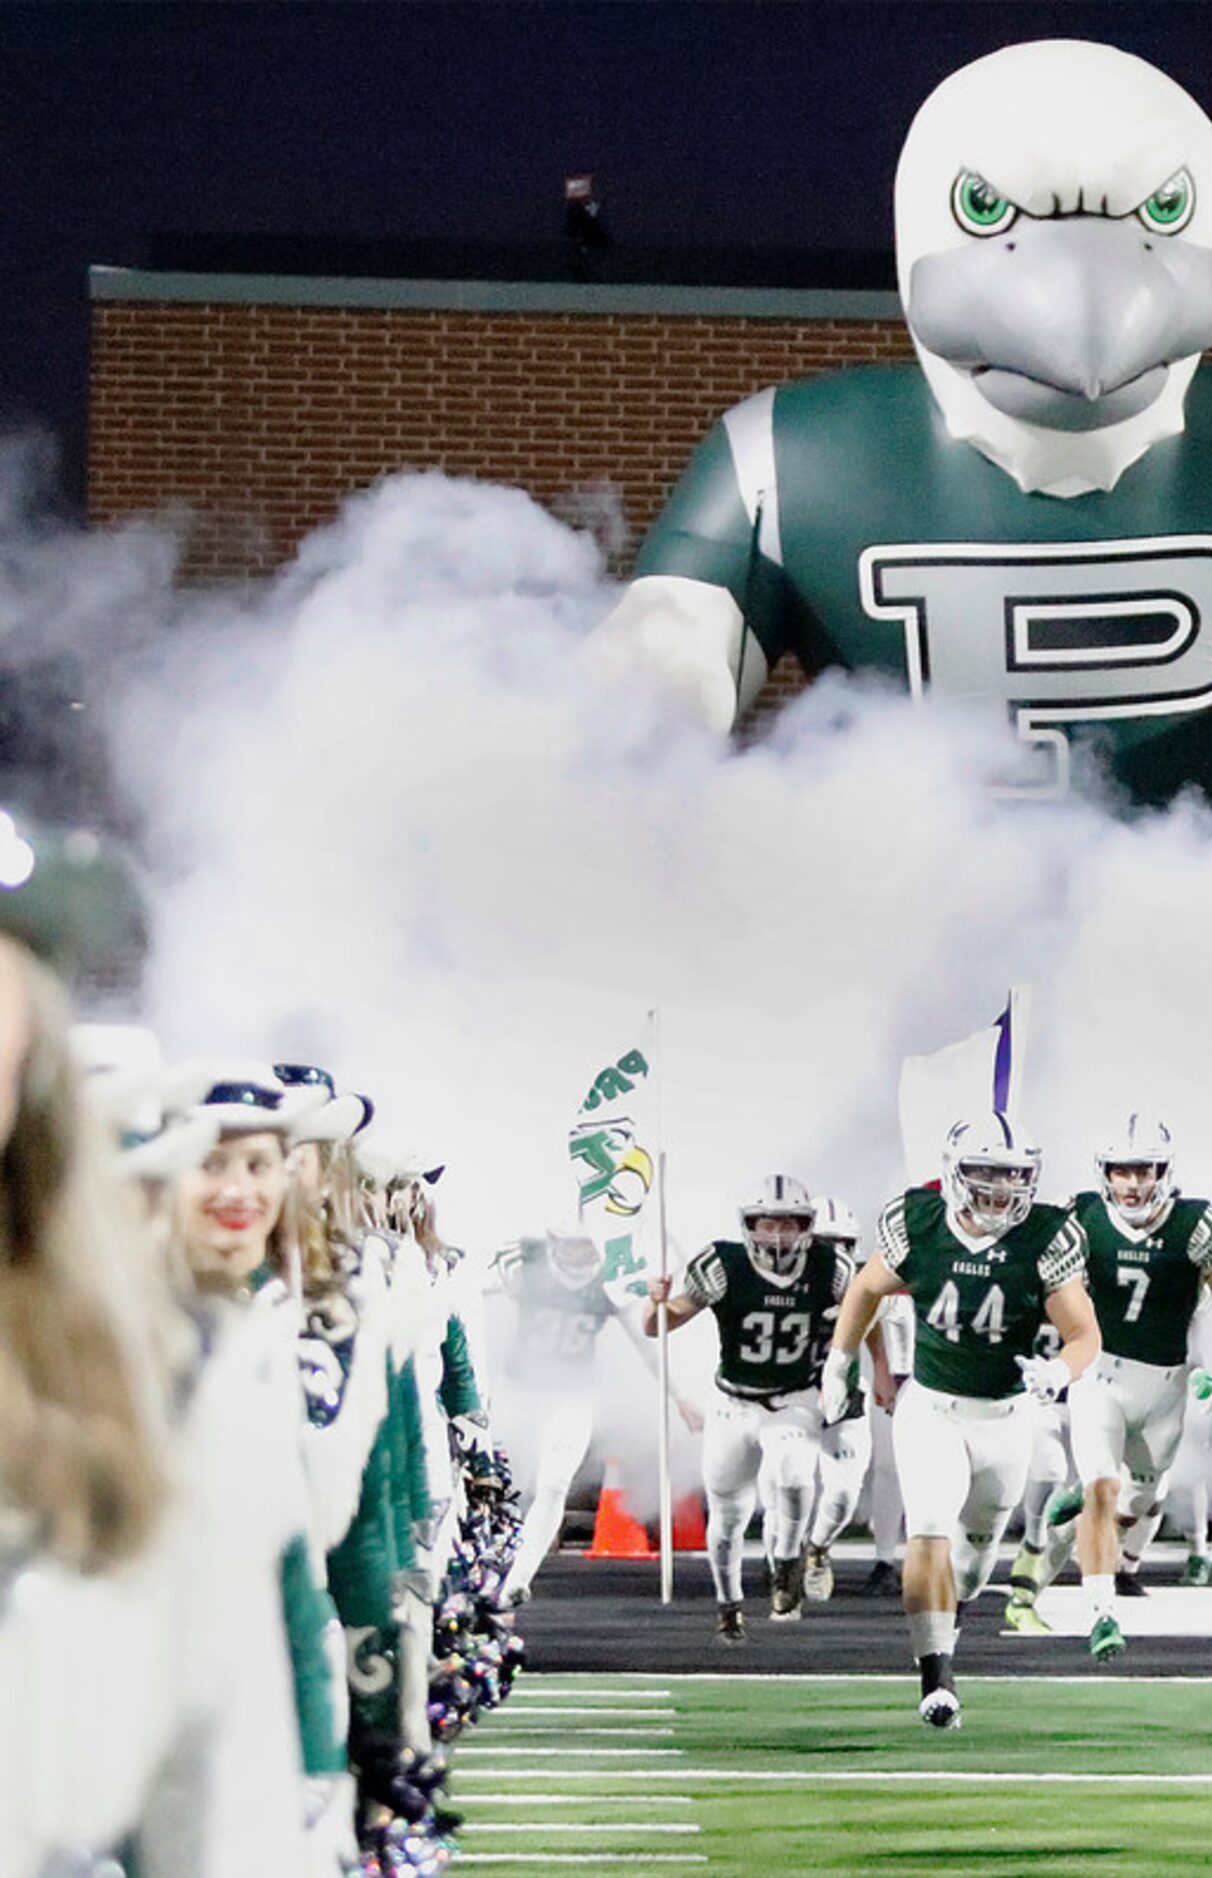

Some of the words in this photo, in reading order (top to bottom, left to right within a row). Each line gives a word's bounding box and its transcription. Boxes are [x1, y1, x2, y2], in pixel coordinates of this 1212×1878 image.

[952, 1261, 991, 1277] EAGLES
[1117, 1250, 1151, 1263] EAGLES
[763, 1295, 796, 1307] EAGLES
[1116, 1267, 1151, 1322] 7
[926, 1280, 1008, 1344] 44
[740, 1312, 811, 1365] 33
